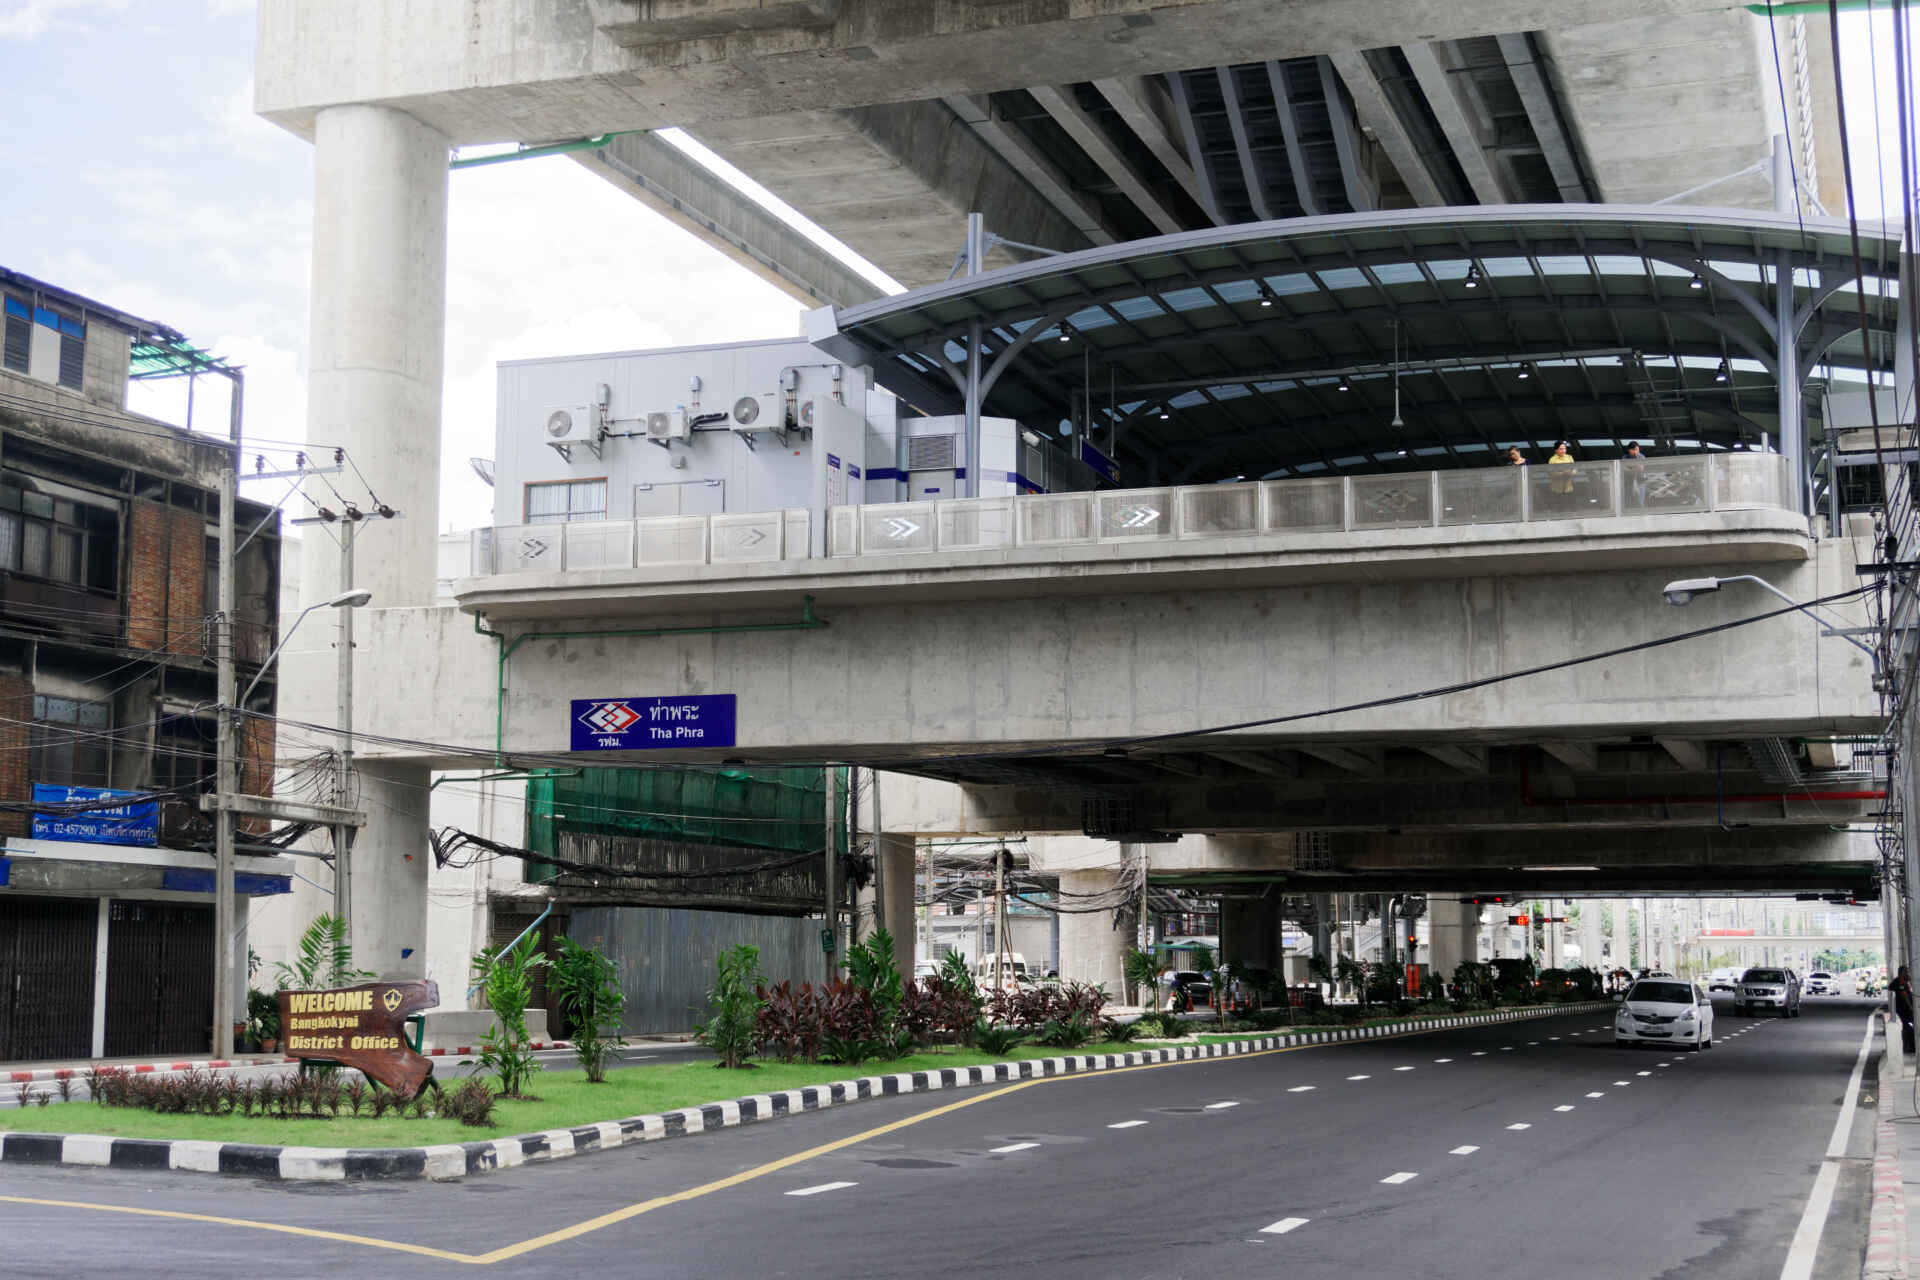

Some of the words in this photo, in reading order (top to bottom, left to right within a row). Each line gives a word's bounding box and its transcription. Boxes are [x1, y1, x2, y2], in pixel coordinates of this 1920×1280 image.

[649, 699, 700, 721] ท่าพระ
[649, 727, 672, 739] Tha
[675, 726, 704, 739] Phra
[598, 735, 622, 747] รฟม.
[289, 990, 373, 1014] WELCOME
[289, 1015, 359, 1031] Bangkokyai
[289, 1035, 344, 1050] District
[350, 1035, 399, 1050] Office
